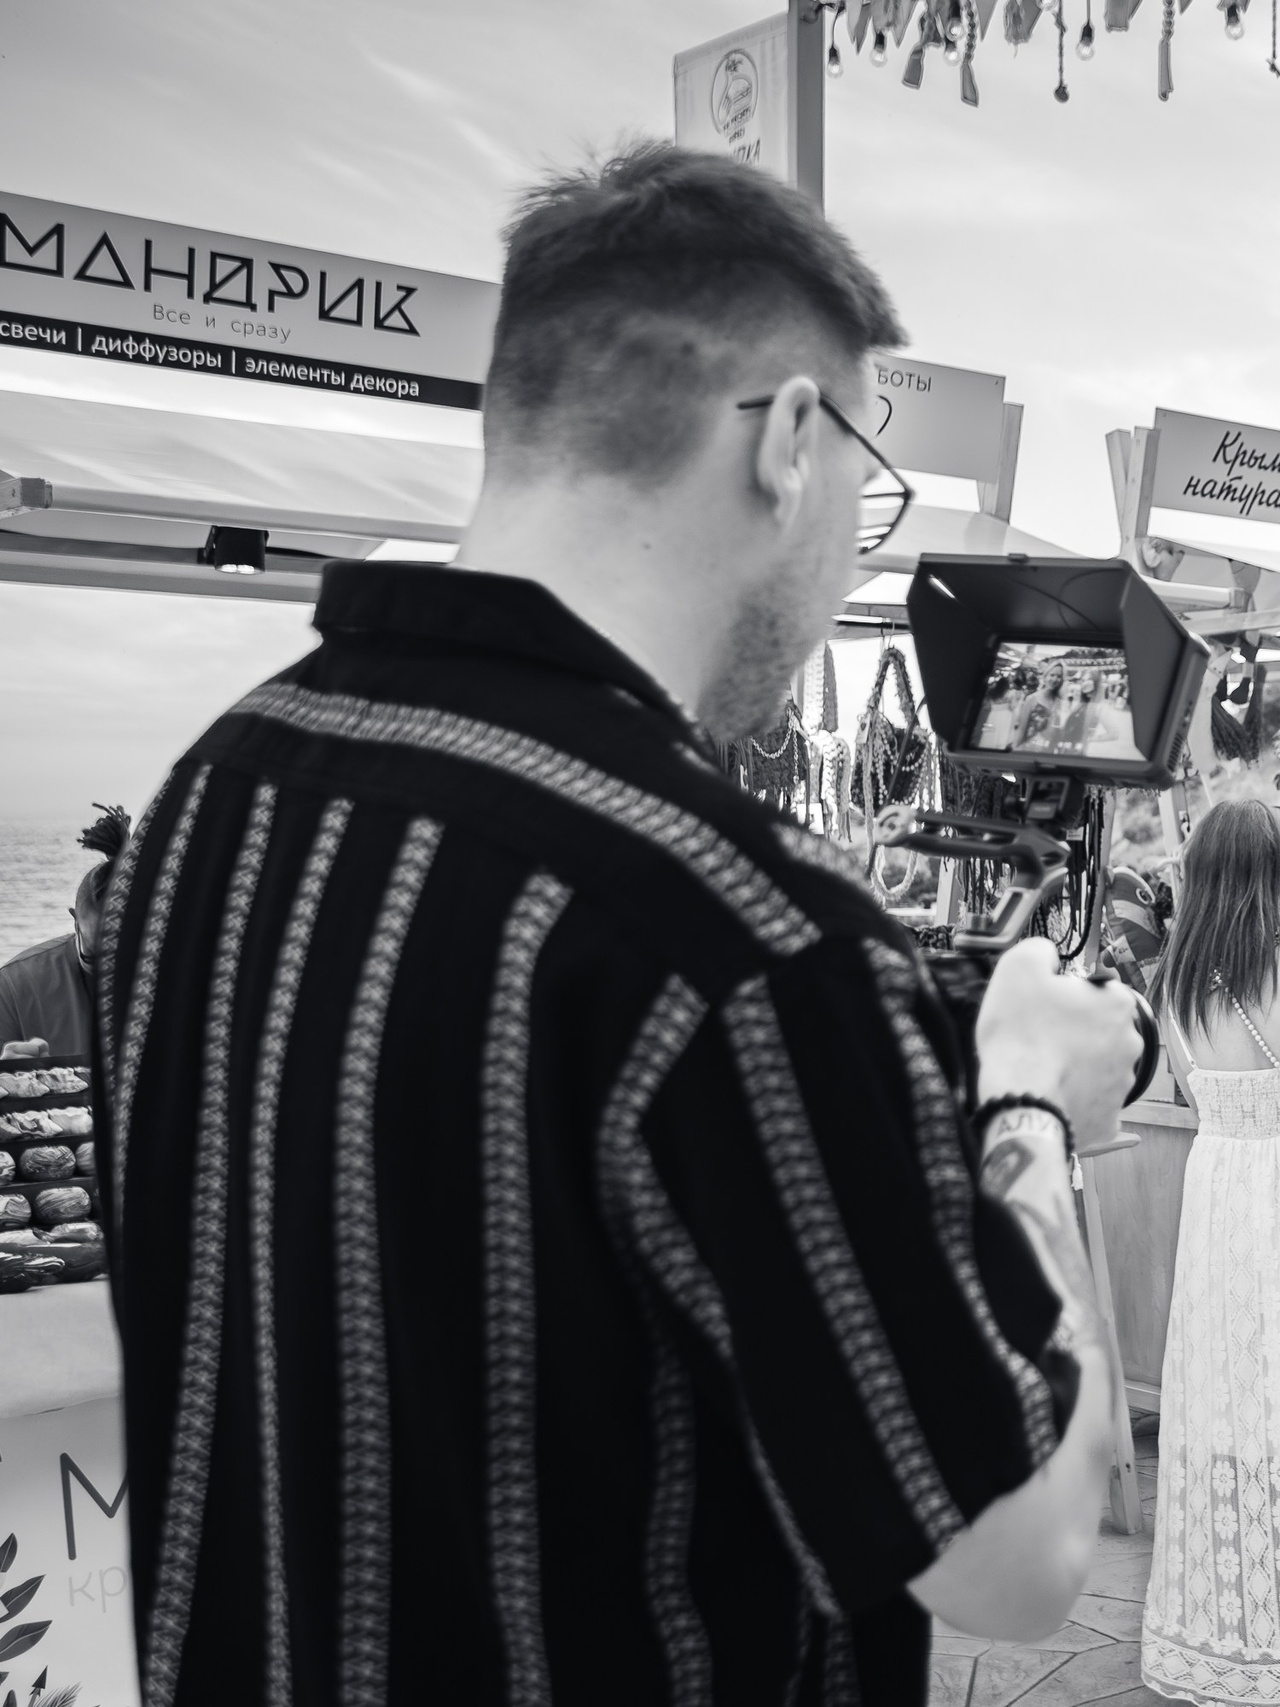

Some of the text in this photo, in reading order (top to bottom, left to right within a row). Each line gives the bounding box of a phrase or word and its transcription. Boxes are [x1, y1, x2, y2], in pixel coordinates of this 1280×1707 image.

[0, 213, 421, 337] МАНДРИК
[0, 320, 420, 397] свечи диффузоры элементы декора
[152, 303, 292, 343] Все и сразу
